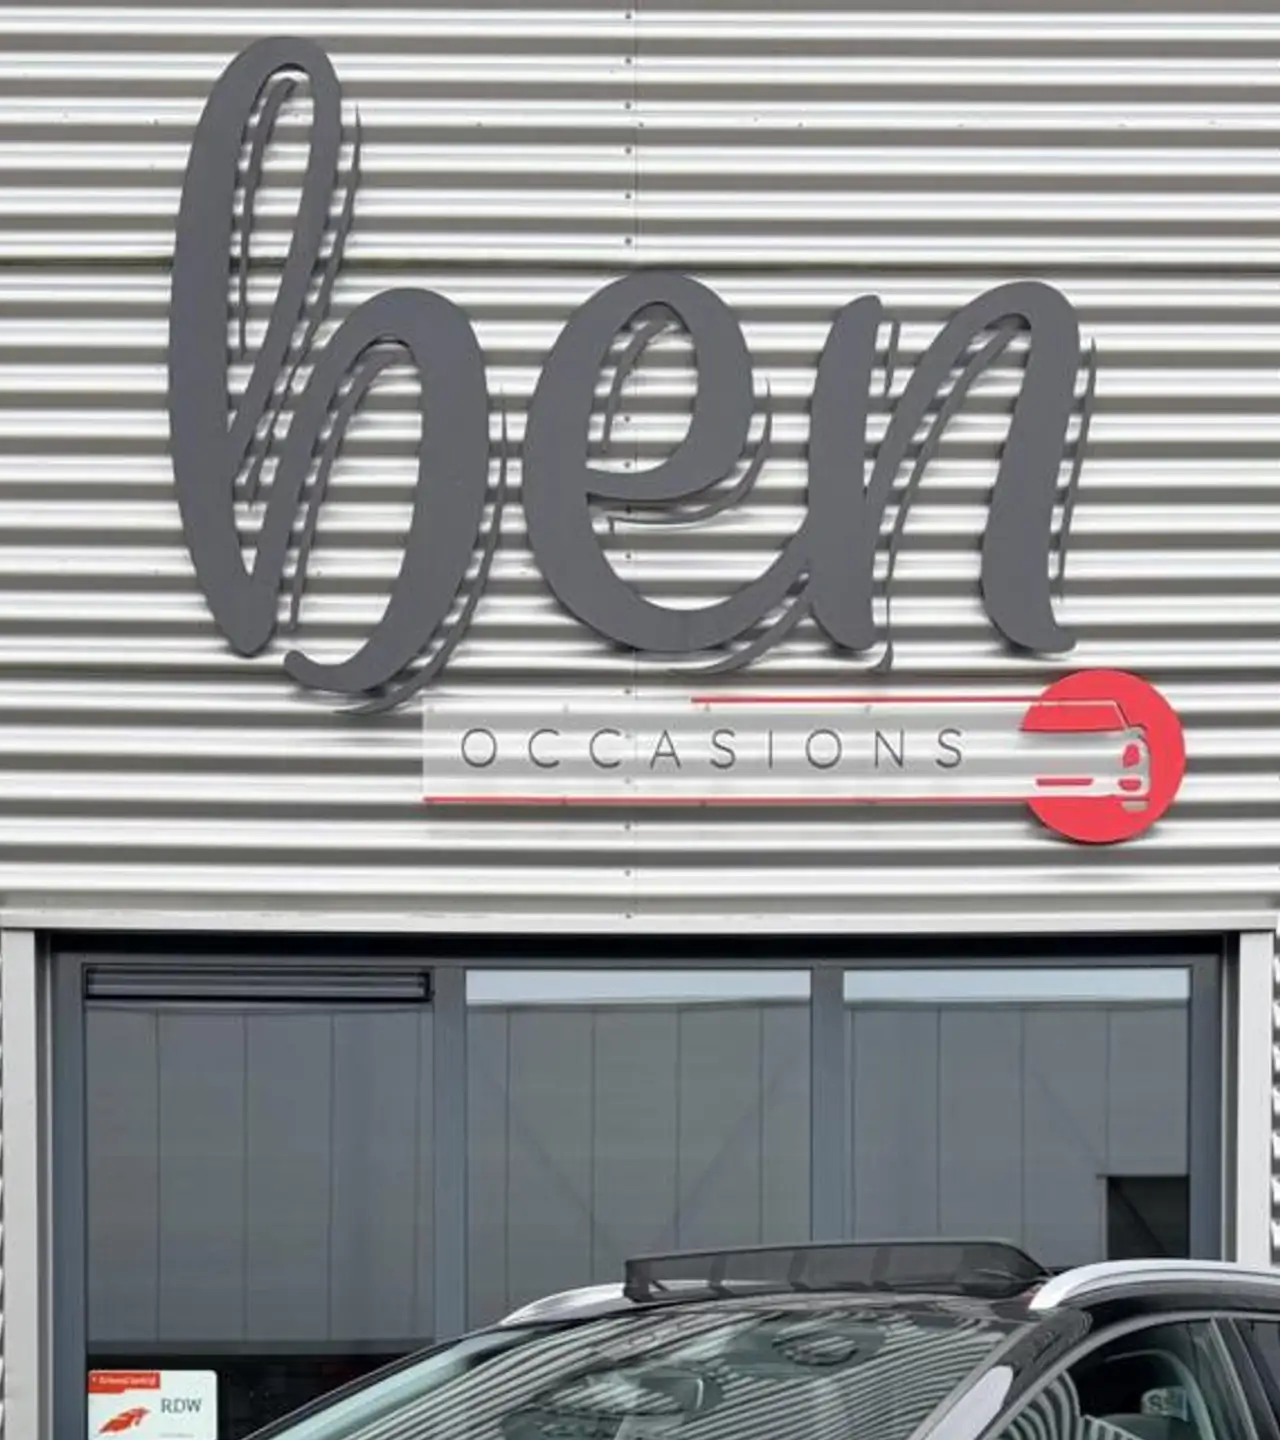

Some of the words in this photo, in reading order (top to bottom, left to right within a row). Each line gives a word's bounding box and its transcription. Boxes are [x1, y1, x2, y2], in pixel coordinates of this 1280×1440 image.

[168, 36, 1078, 695] ben
[460, 727, 963, 770] OCCASIONS
[160, 1397, 203, 1414] RDW
